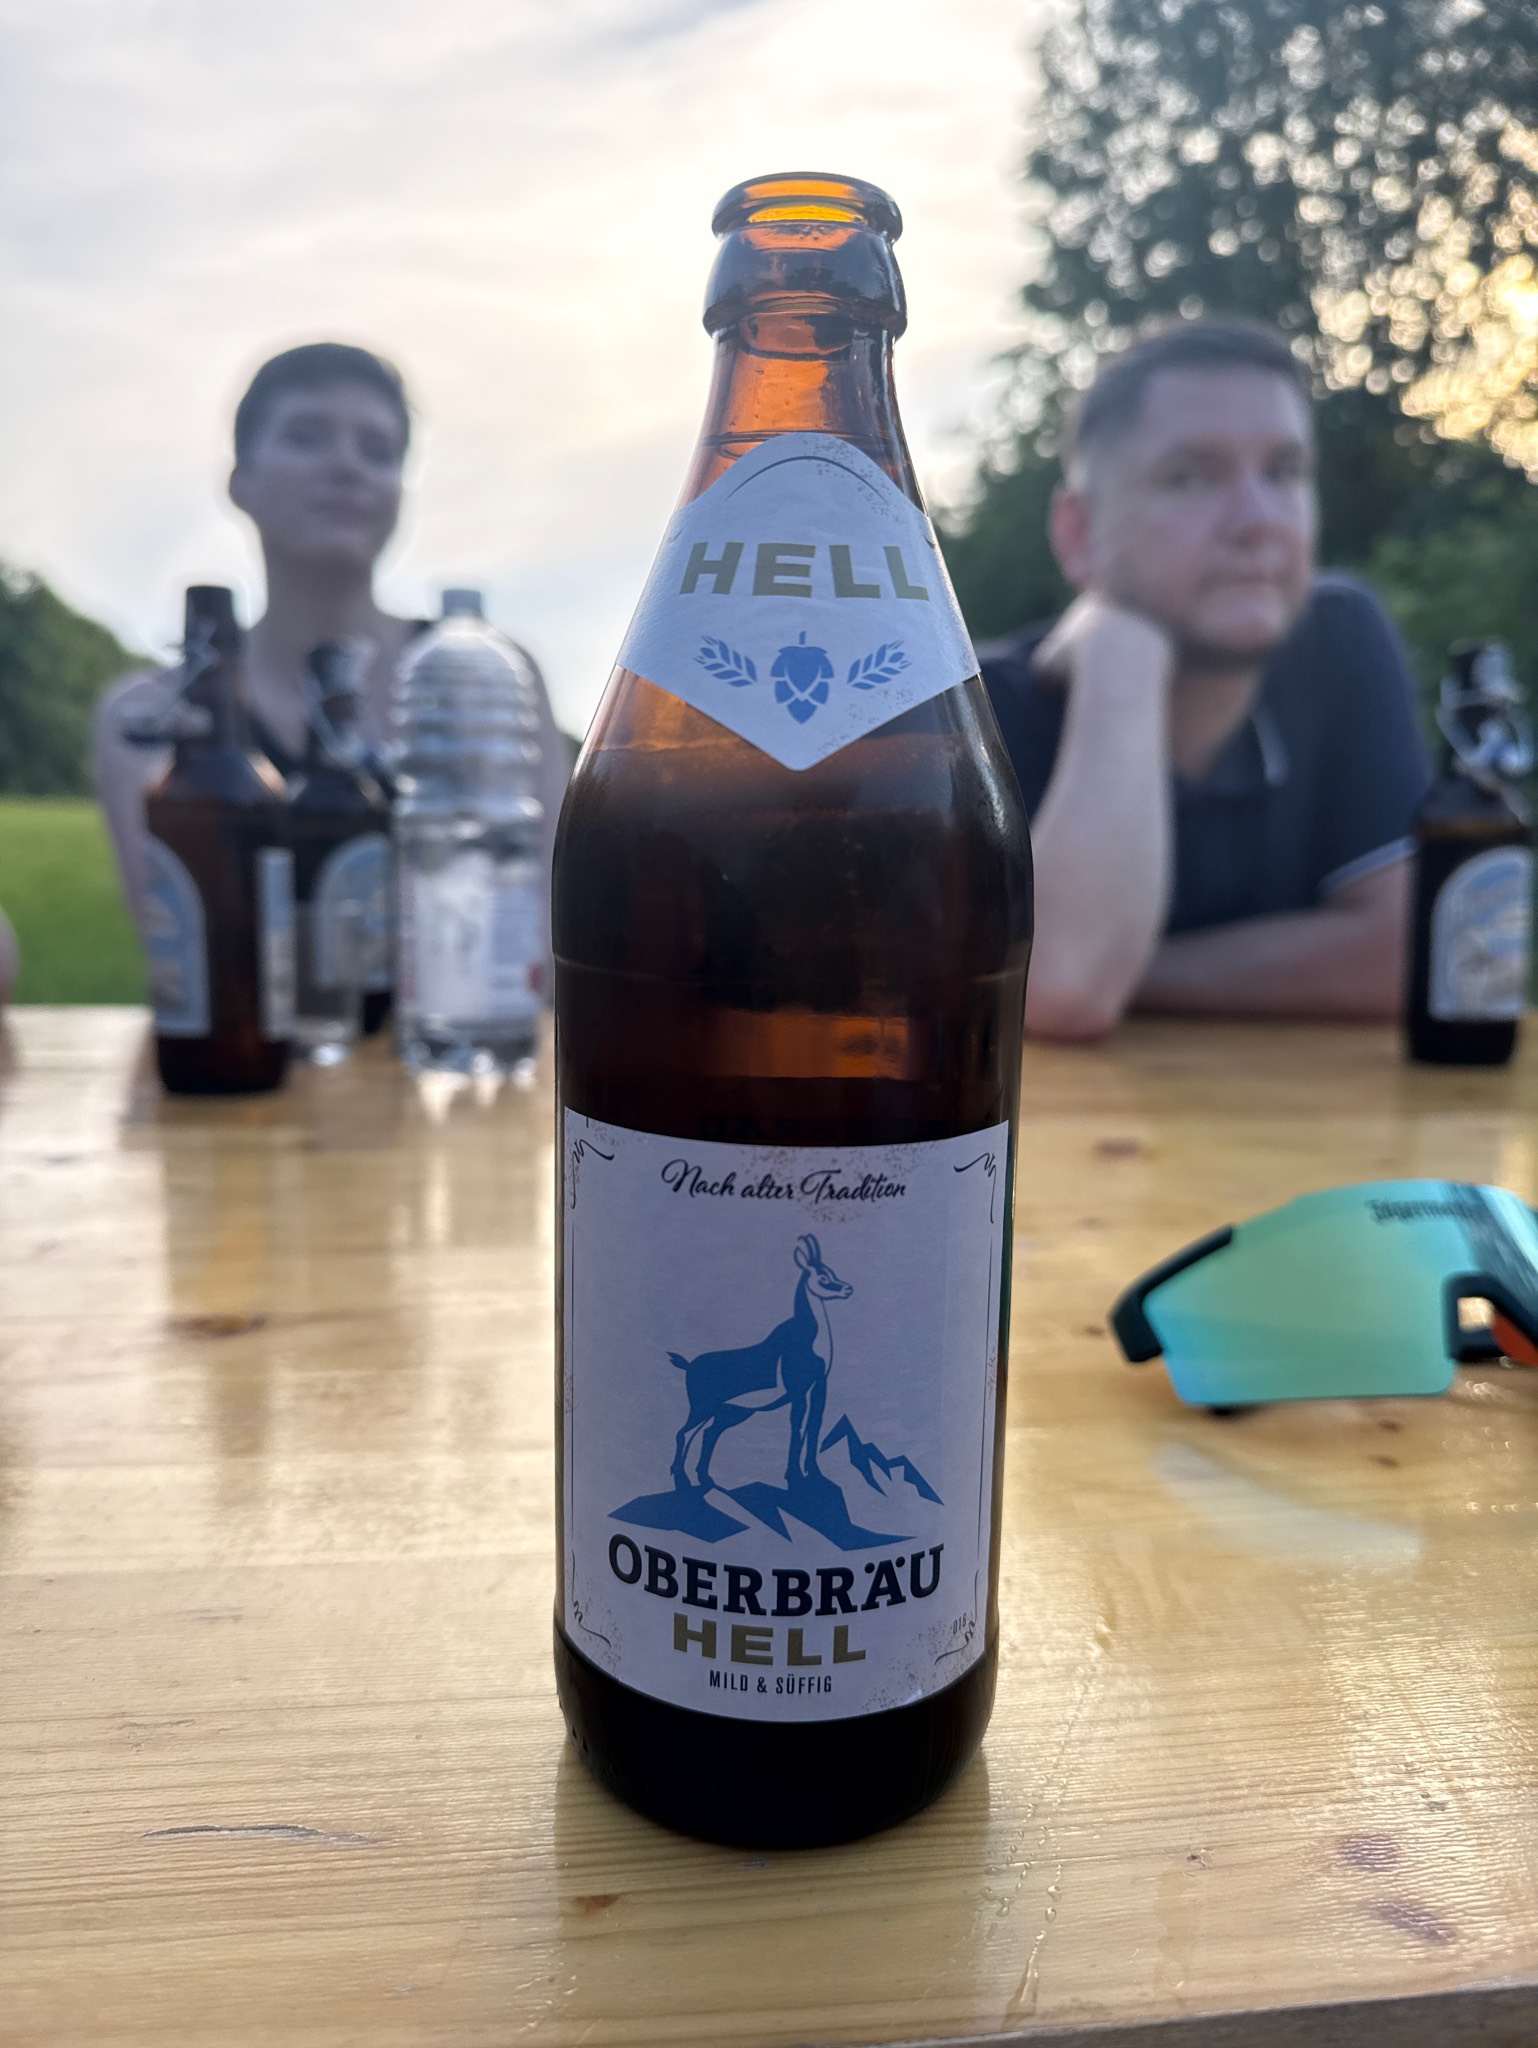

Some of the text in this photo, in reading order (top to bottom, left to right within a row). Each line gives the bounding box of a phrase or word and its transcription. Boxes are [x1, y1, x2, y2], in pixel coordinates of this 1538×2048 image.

[679, 541, 930, 601] HELL
[661, 1158, 906, 1203] Nach alter Tradition
[608, 1533, 944, 1617] OBERBRÄU
[673, 1612, 866, 1666] HELL
[709, 1669, 832, 1694] MILD & SÜFFIG
